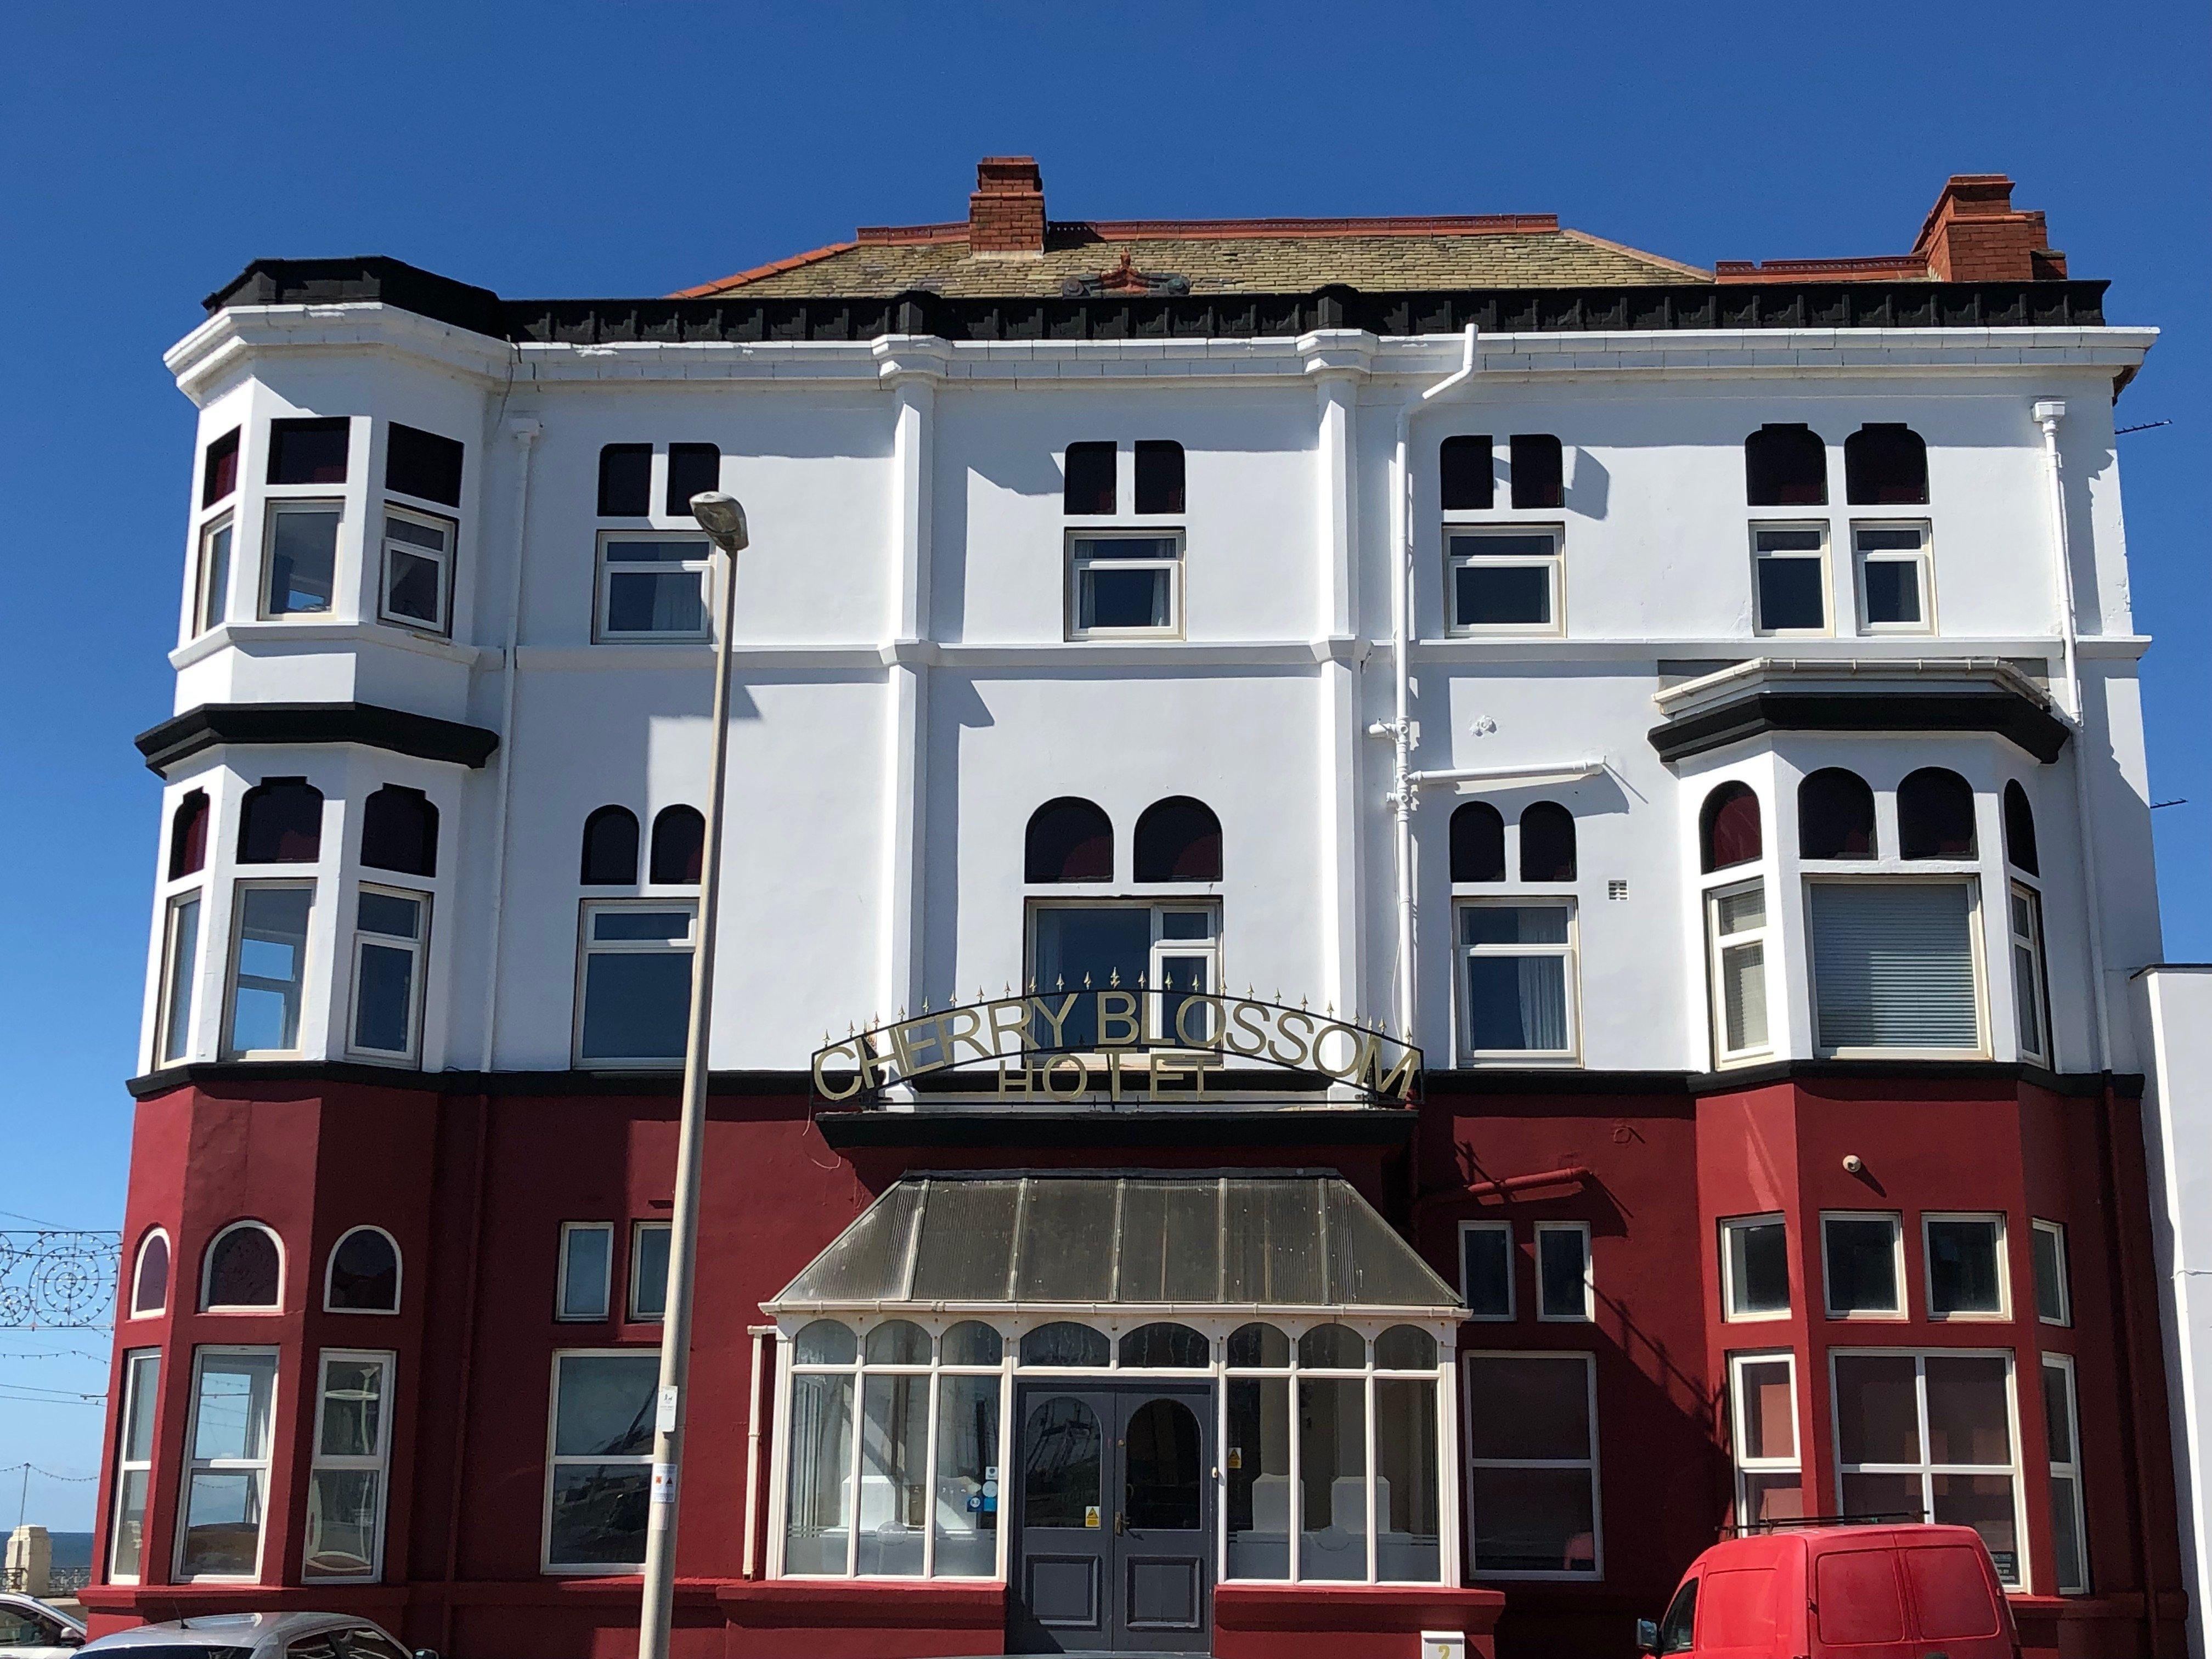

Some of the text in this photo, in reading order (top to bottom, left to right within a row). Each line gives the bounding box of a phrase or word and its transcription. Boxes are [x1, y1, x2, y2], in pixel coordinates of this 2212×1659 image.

[814, 991, 1420, 1101] CHERRY BLOSSOM
[998, 1046, 1224, 1102] HOTEL
